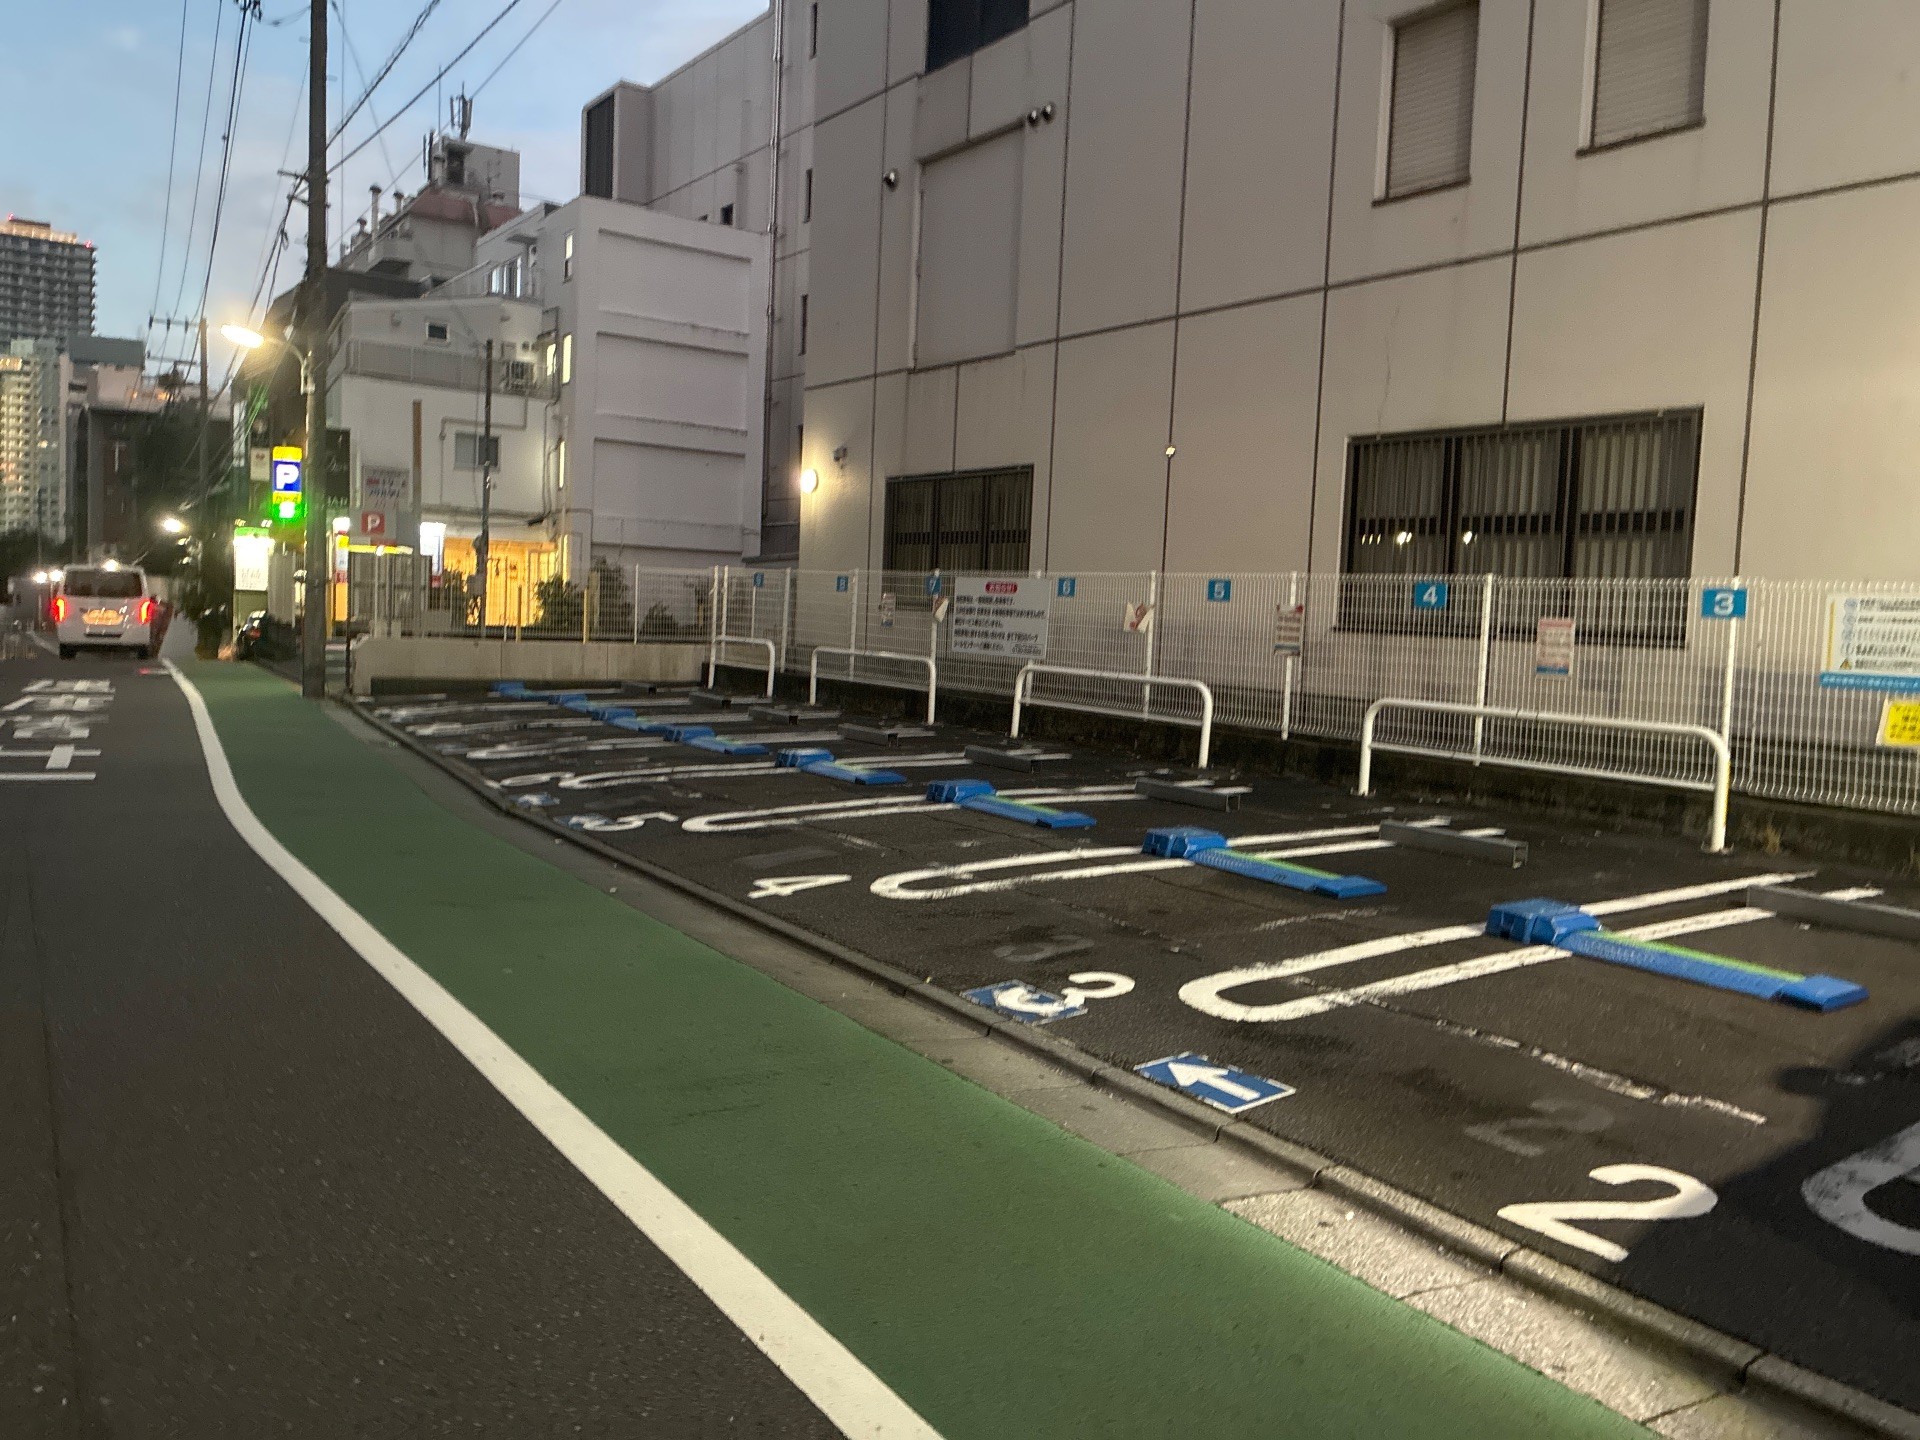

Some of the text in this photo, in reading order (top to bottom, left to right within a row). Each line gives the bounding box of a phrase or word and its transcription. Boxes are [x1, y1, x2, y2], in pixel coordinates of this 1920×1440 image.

[276, 464, 300, 490] P
[367, 515, 381, 531] P
[1062, 580, 1071, 594] 6
[1214, 581, 1226, 599] 5
[1423, 585, 1438, 605] 4
[1713, 592, 1735, 616] 3
[747, 874, 852, 899] 4
[993, 971, 1136, 1017] 3
[1497, 1163, 1719, 1263] 2
